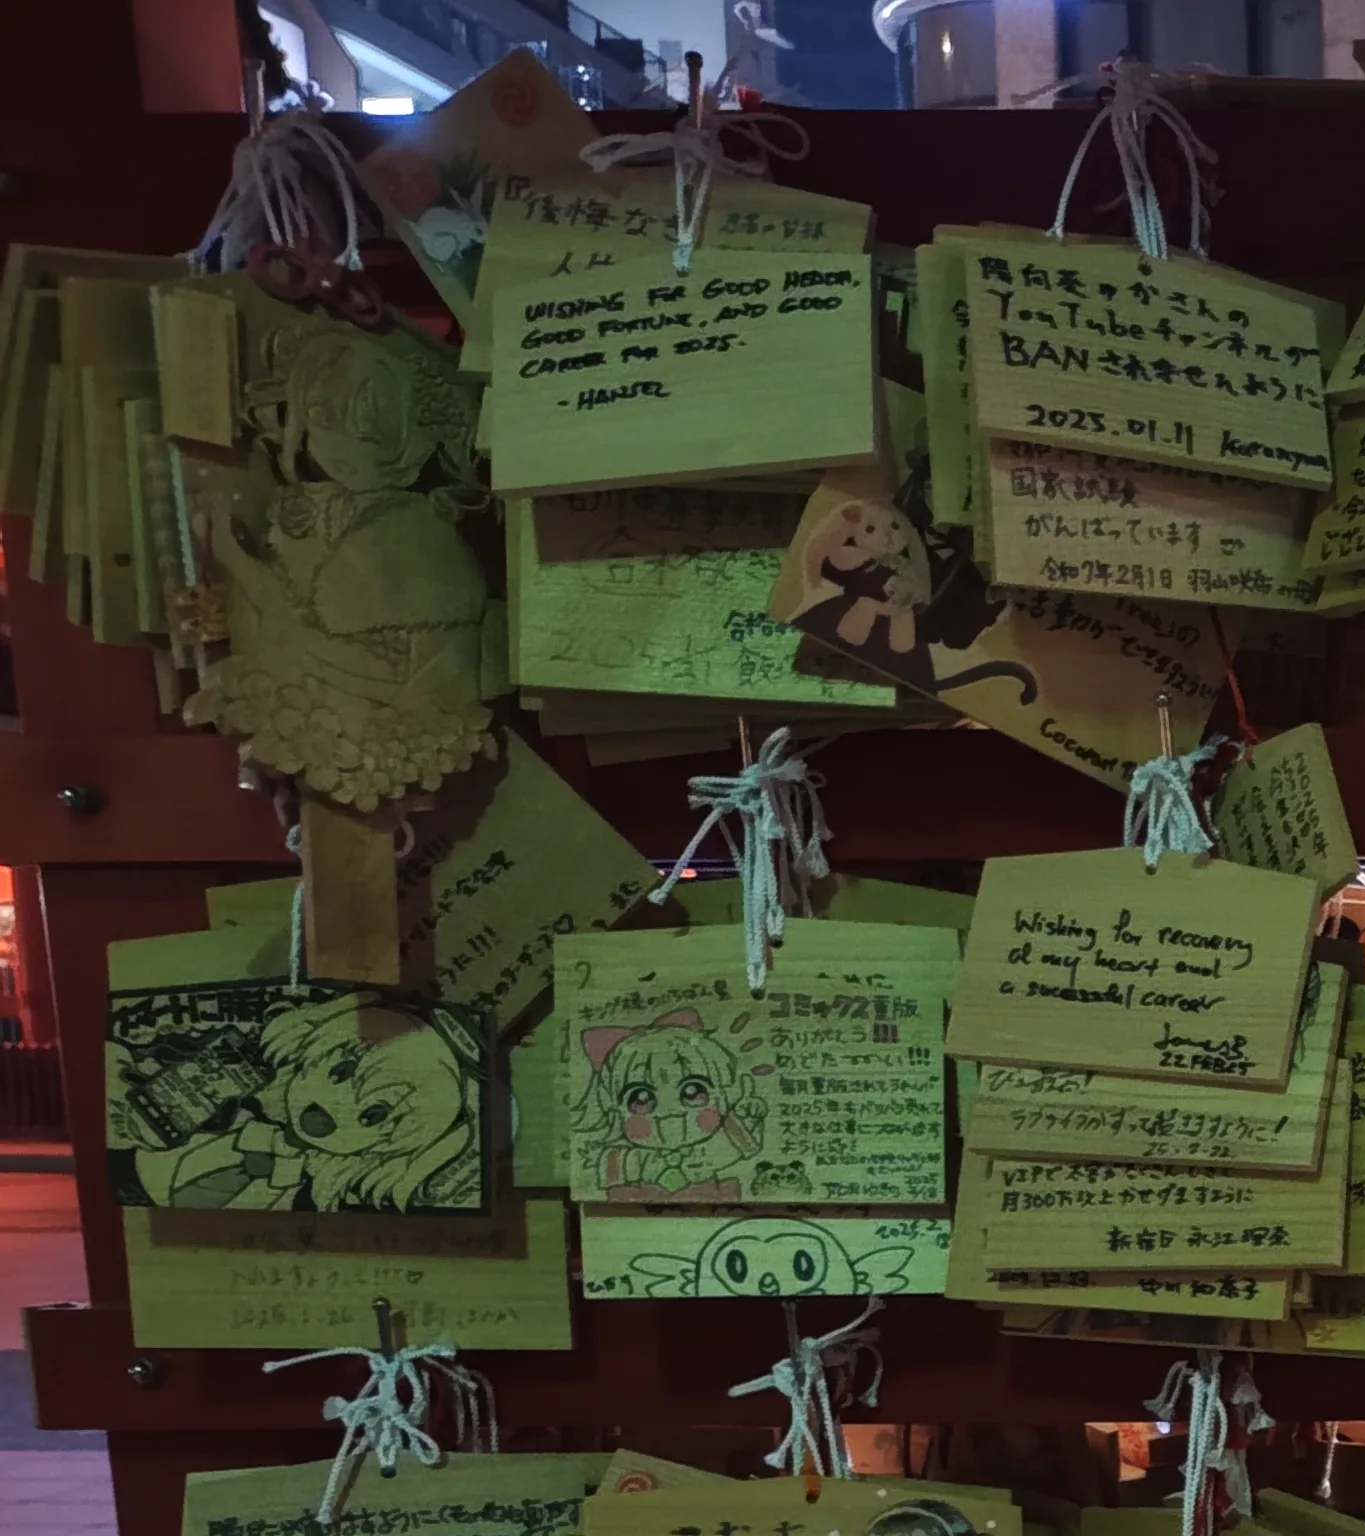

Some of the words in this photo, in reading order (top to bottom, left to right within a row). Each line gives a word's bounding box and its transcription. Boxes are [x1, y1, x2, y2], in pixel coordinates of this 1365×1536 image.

[521, 328, 584, 349] GOOD
[777, 296, 842, 314] GOOD
[526, 292, 625, 321] WISHING
[702, 278, 770, 298] GOOD
[1026, 403, 1194, 454] 2025.01.11
[1013, 909, 1098, 951] Wishing
[1111, 908, 1143, 946] for
[1157, 927, 1254, 969] recovery
[1040, 951, 1081, 988] my
[1095, 949, 1158, 976] heart
[1175, 957, 1222, 978] and
[1139, 992, 1225, 1013] career
